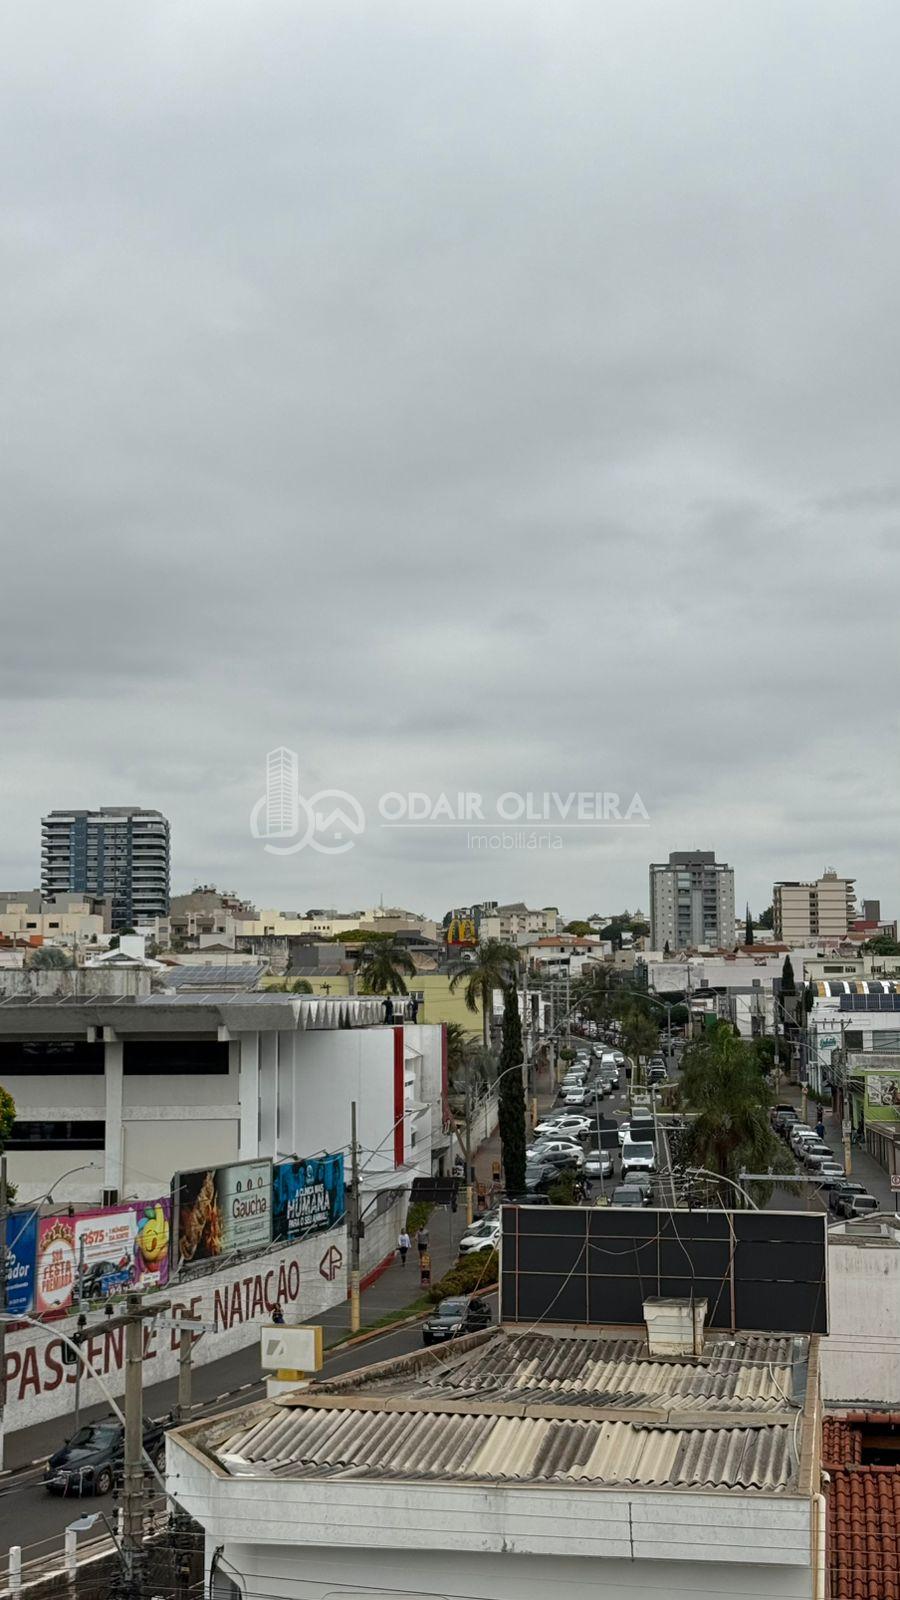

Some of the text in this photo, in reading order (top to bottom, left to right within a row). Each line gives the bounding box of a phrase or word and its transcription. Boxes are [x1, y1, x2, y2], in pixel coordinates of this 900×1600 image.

[232, 1193, 267, 1218] Gaucha
[287, 1191, 330, 1219] HUMANA
[214, 1259, 299, 1334] NATAÇÃO
